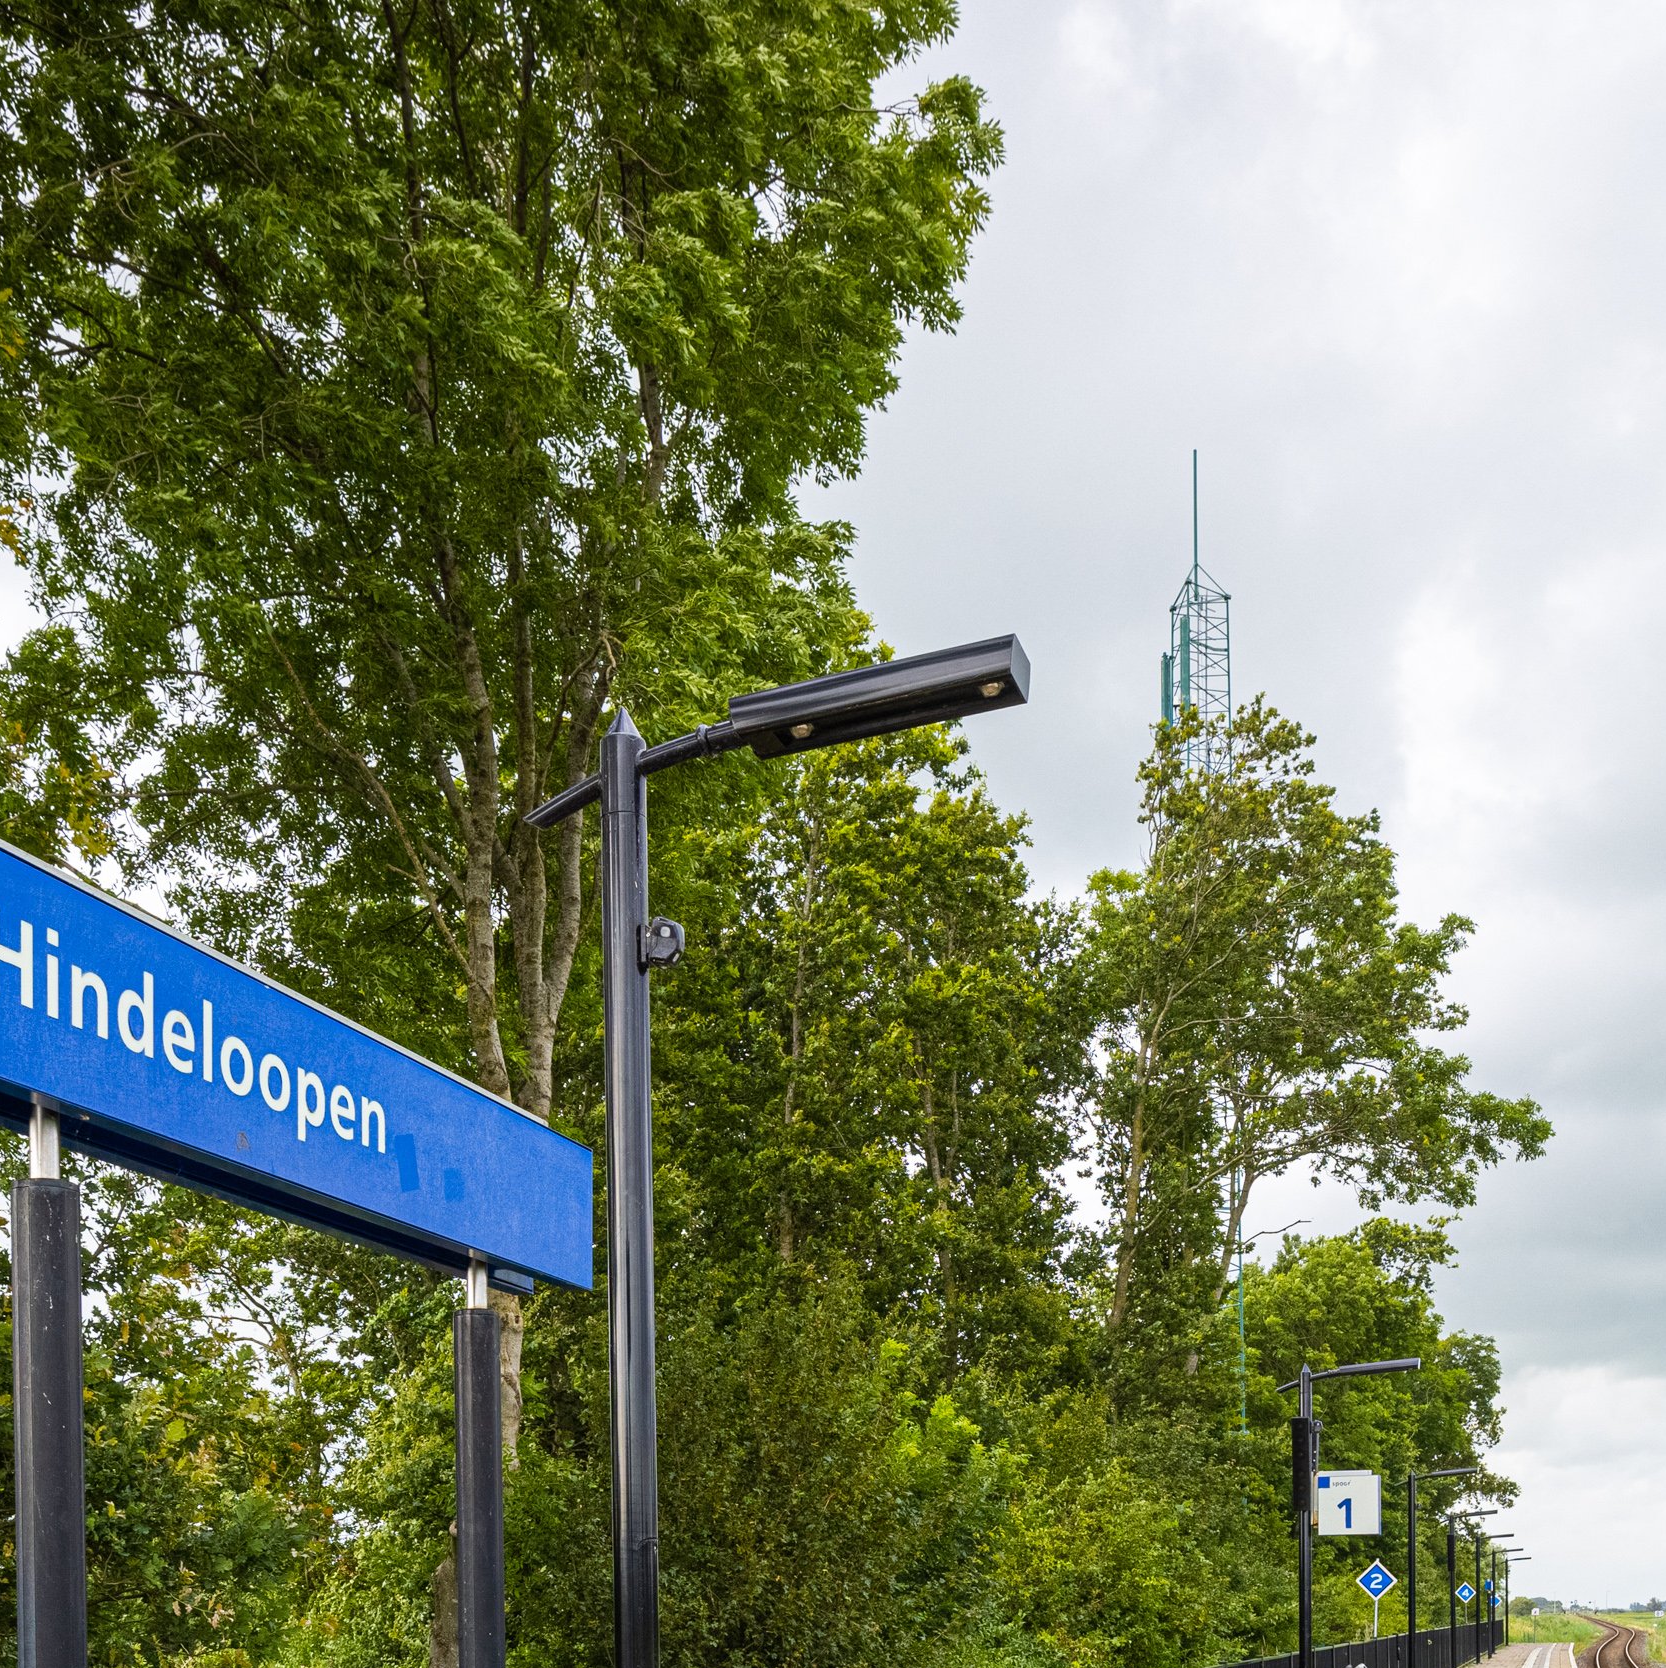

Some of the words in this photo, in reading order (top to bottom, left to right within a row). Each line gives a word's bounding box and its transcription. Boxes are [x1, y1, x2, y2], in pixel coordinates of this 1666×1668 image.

[1337, 1497, 1352, 1529] 1
[1369, 1573, 1383, 1589] 2
[1461, 1588, 1470, 1597] 4
